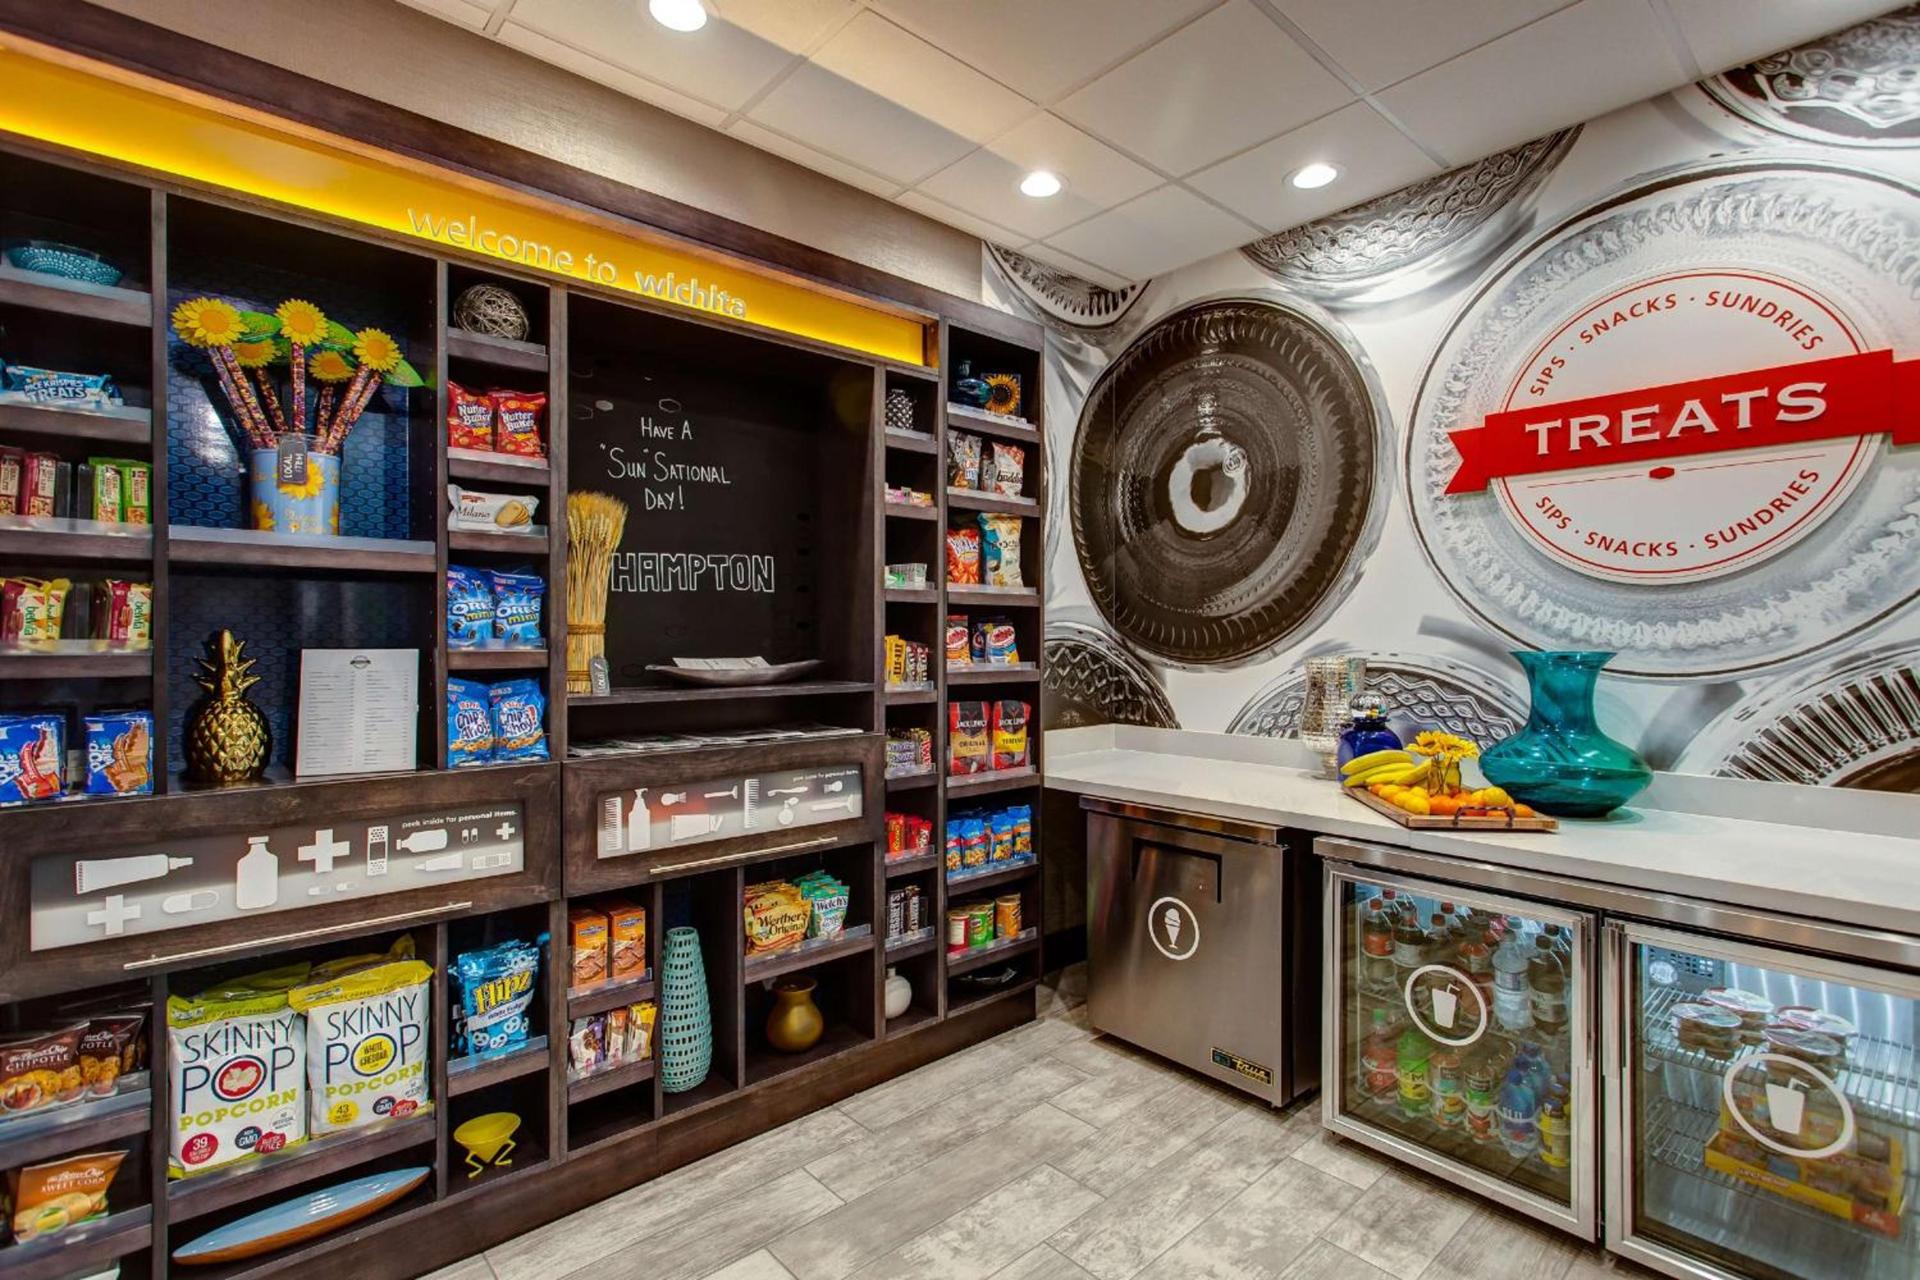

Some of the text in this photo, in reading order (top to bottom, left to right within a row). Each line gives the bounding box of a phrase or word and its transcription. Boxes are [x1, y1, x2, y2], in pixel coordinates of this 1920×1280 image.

[407, 207, 747, 319] welcome to wichita
[1530, 290, 1824, 396] SIPS SNACKS SUNDRIES
[26, 387, 85, 403] TREATS
[681, 420, 693, 440] A
[1525, 382, 1828, 455] TREATS
[645, 486, 685, 510] DAY!
[1536, 469, 1819, 557] SIPS SNACKS SUNDRIES
[611, 552, 776, 592] HAMPTON
[459, 812, 492, 822] personal
[6, 1053, 71, 1072] CHIPOTLE
[326, 1023, 420, 1084] POP
[181, 1046, 295, 1114] POP
[325, 1060, 423, 1098] POPCORN
[179, 1088, 297, 1132] POPCORN
[193, 1136, 208, 1150] 39
